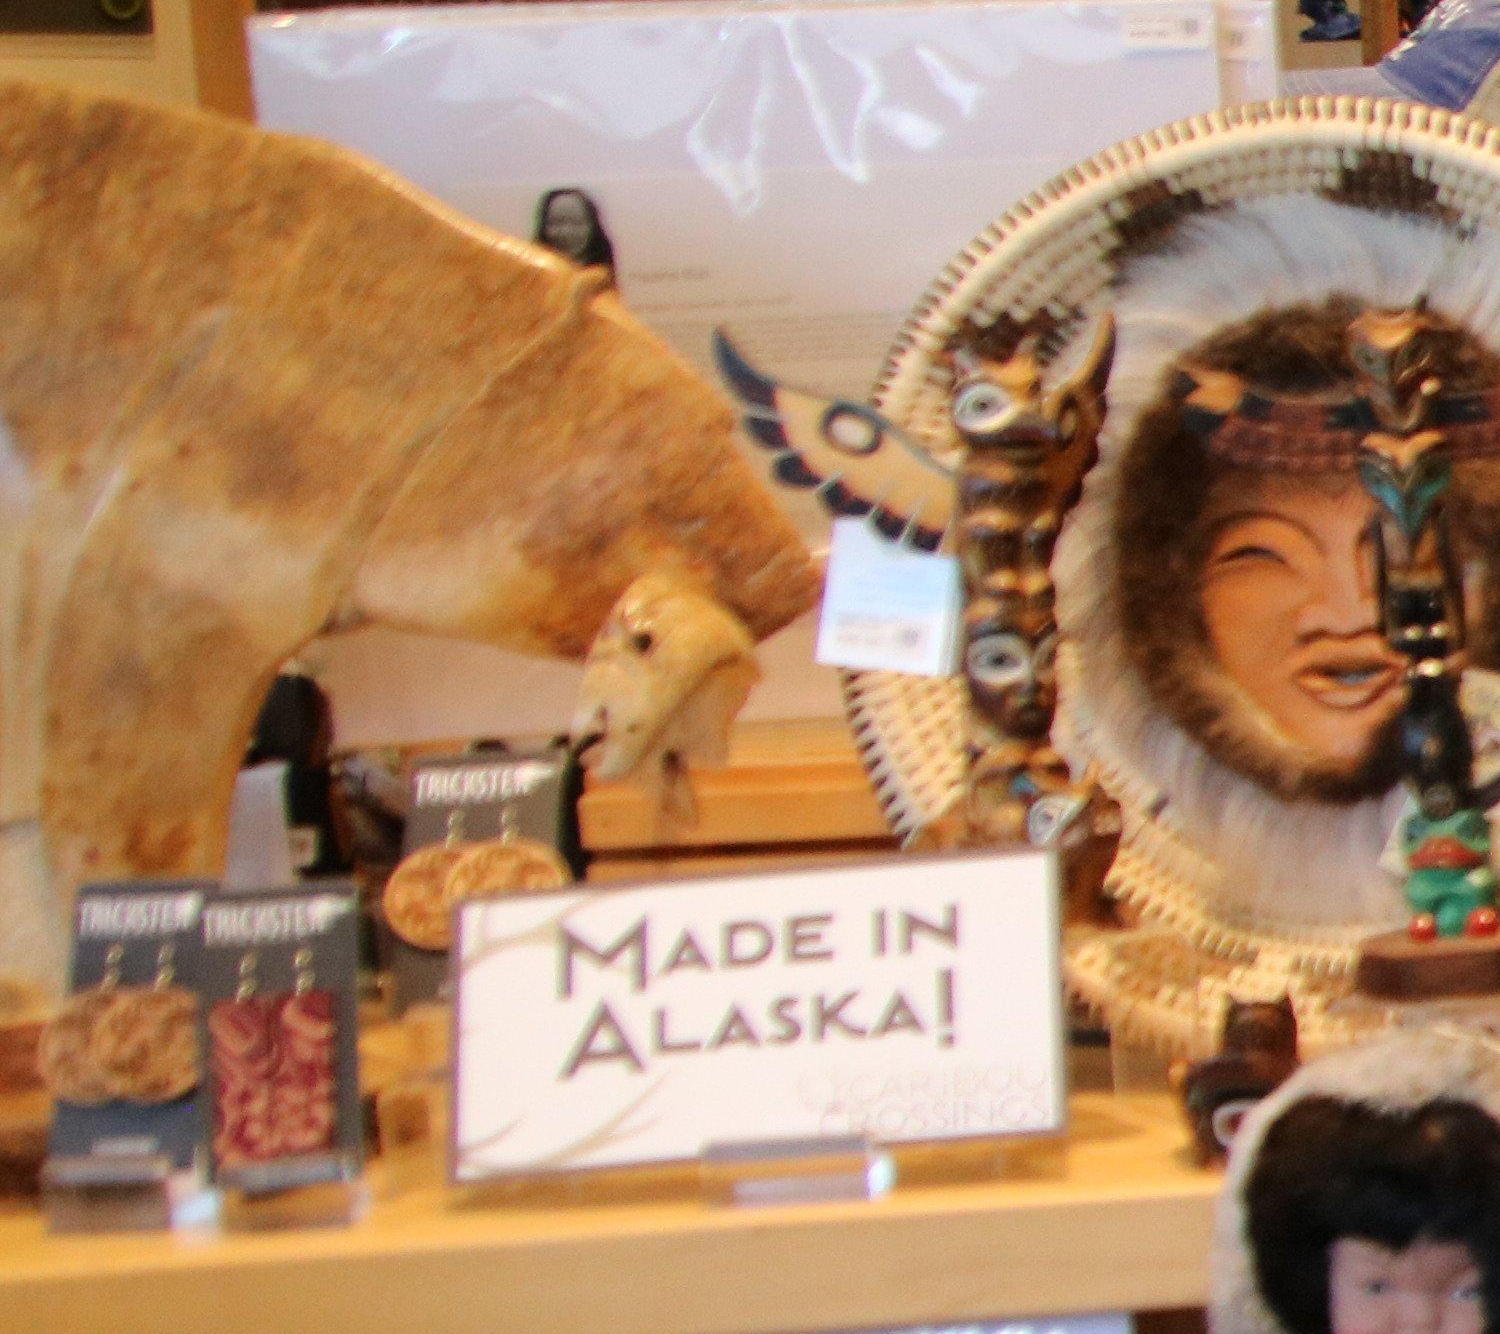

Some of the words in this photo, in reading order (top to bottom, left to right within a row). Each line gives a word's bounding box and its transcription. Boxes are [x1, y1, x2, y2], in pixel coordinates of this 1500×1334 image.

[554, 913, 836, 1001] MADE
[871, 901, 959, 958] IN
[557, 967, 956, 1083] ALASKA!
[818, 1090, 1051, 1135] CROSSINGS
[830, 1067, 1050, 1108] CARIBOU
